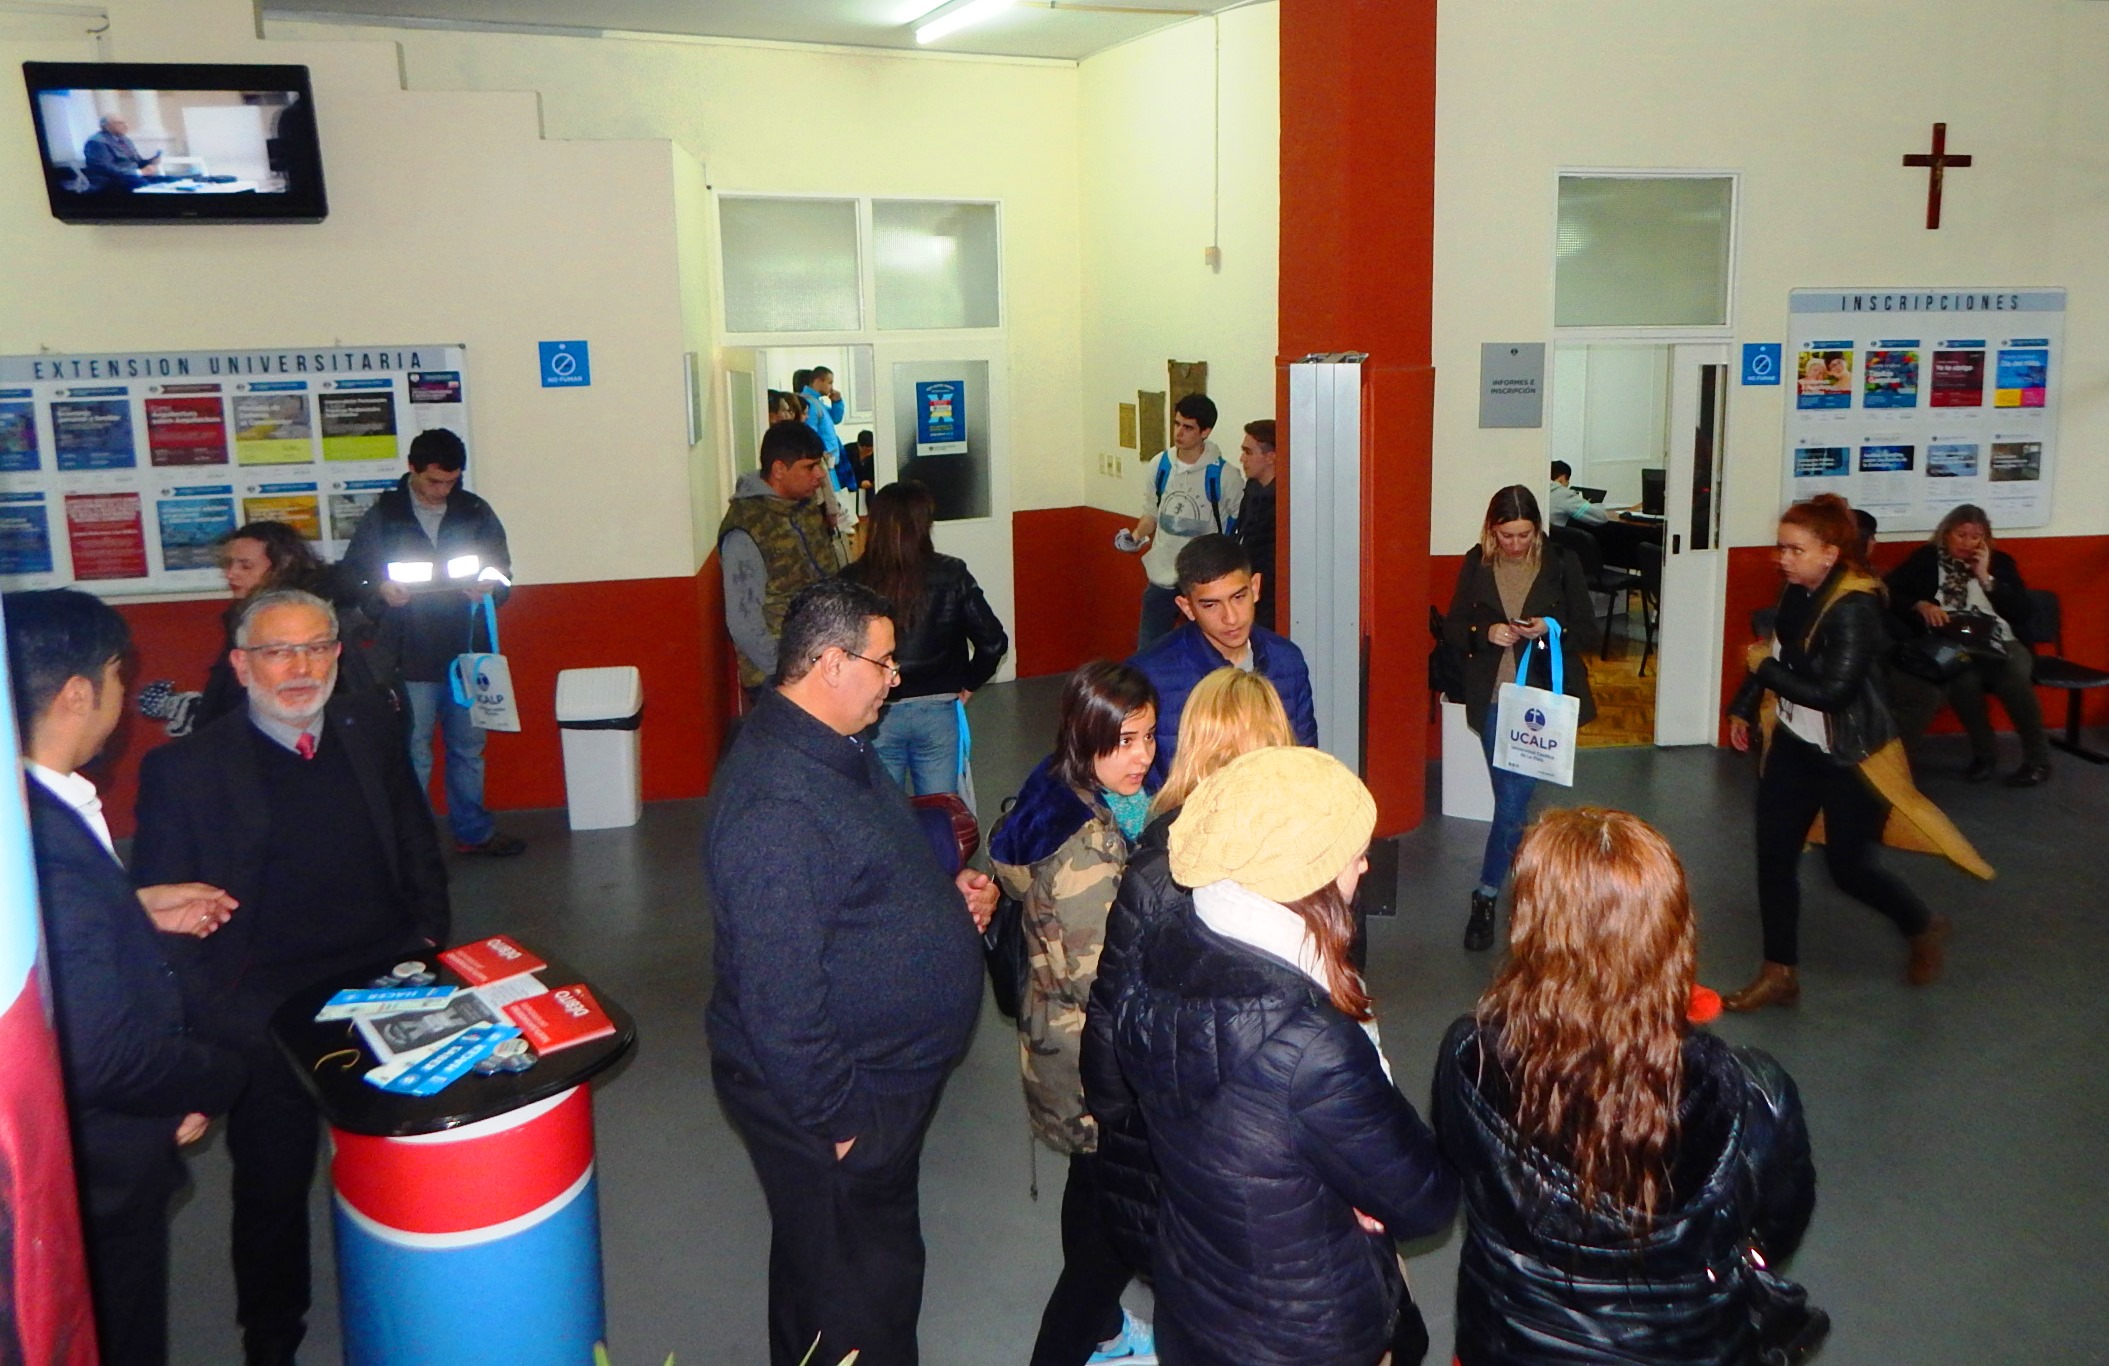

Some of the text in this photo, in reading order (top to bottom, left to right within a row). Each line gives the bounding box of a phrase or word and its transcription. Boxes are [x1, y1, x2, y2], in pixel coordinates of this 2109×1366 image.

[1842, 295, 2018, 311] INSCRIPCIONES
[33, 351, 421, 379] EXTENSION UNIVERSITARIA
[1510, 729, 1558, 751] UCALP
